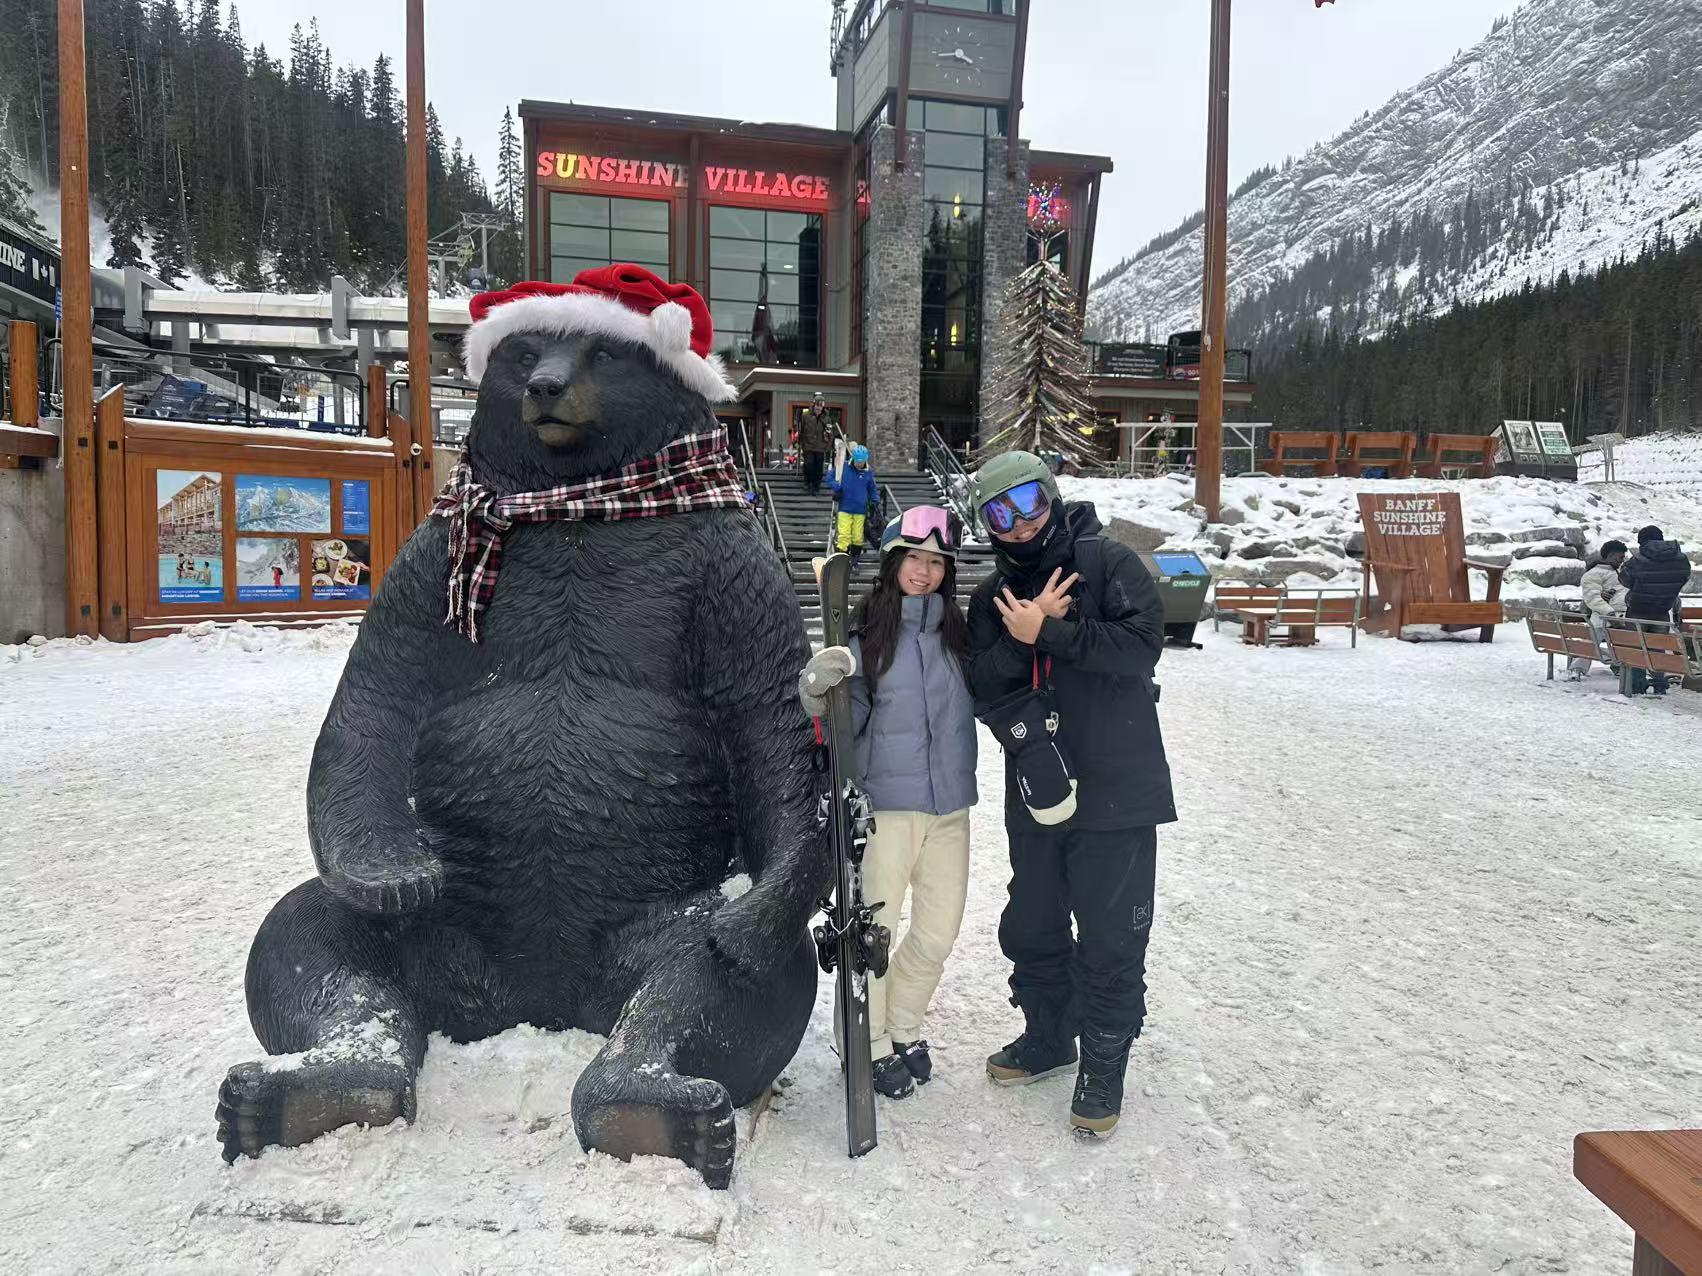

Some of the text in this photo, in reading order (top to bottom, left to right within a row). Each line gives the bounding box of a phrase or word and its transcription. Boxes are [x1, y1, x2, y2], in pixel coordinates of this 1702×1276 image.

[705, 166, 830, 199] VILLAGE
[0, 240, 26, 273] INE
[1385, 499, 1435, 510] BANFF
[1373, 511, 1446, 523] SUNSHINE
[1378, 524, 1440, 535] VILLAGE
